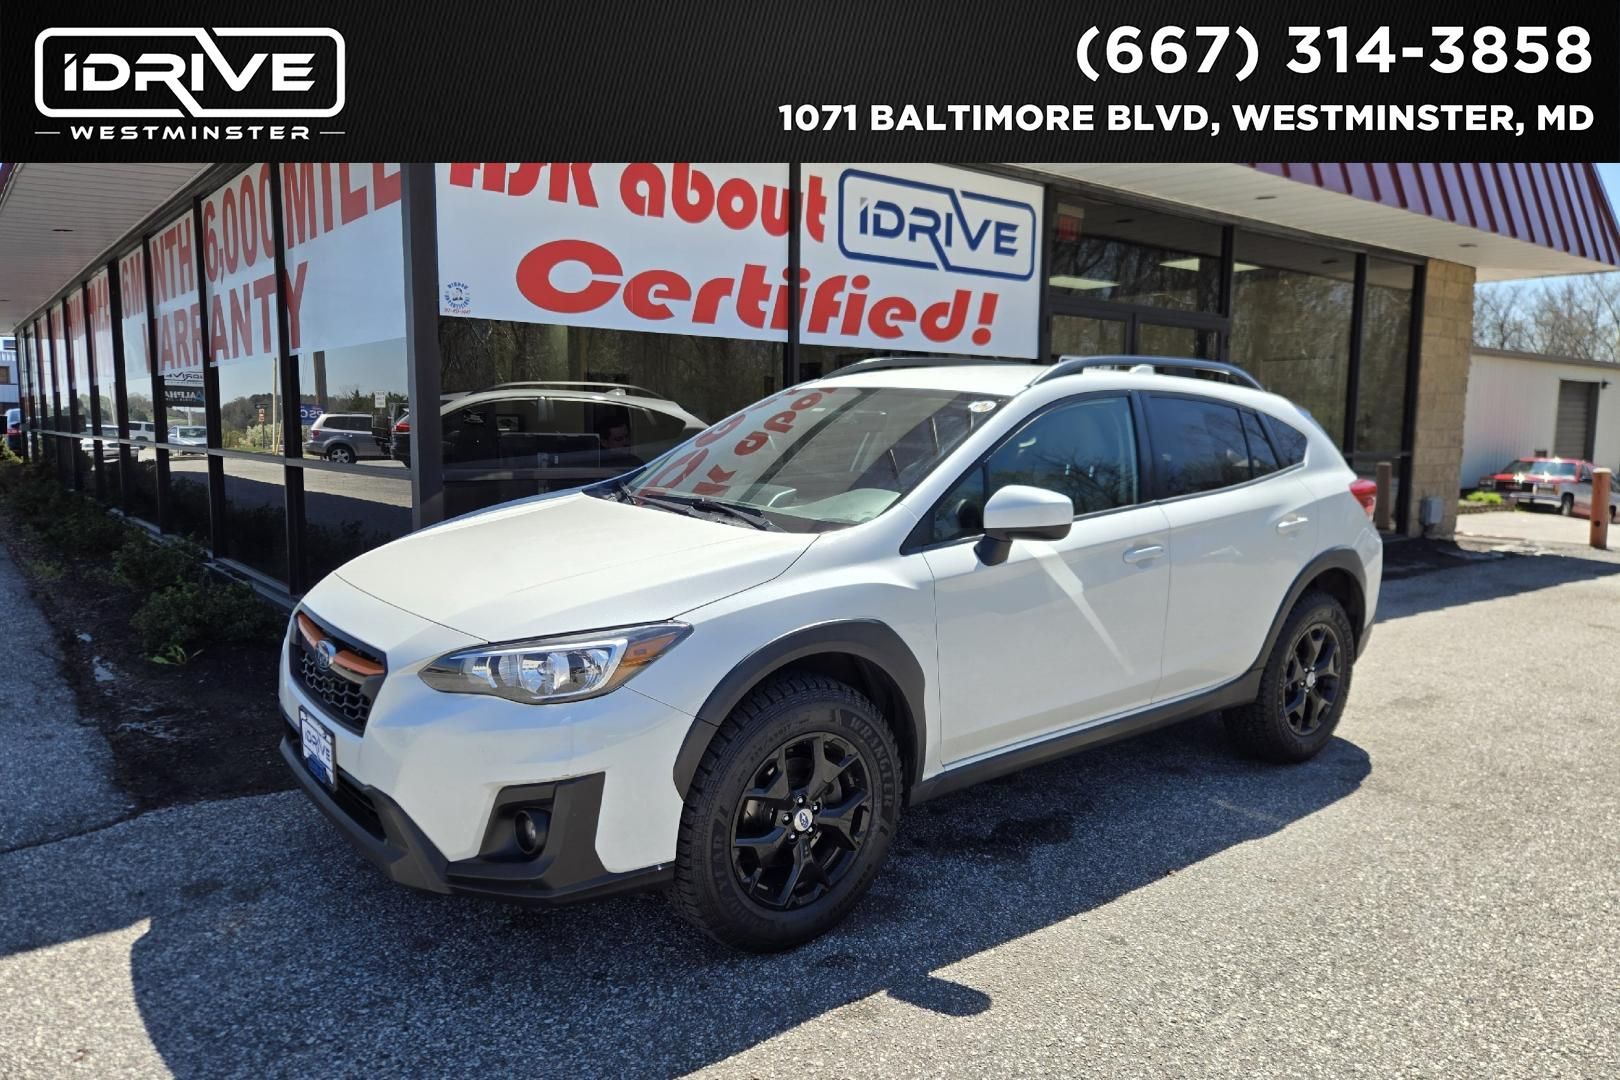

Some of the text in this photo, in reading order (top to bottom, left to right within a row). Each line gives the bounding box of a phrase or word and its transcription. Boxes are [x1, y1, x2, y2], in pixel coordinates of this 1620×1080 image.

[619, 163, 825, 244] about
[130, 216, 195, 316] MNTH
[515, 239, 1000, 347] Certified!
[848, 716, 895, 808] WRANGLER
